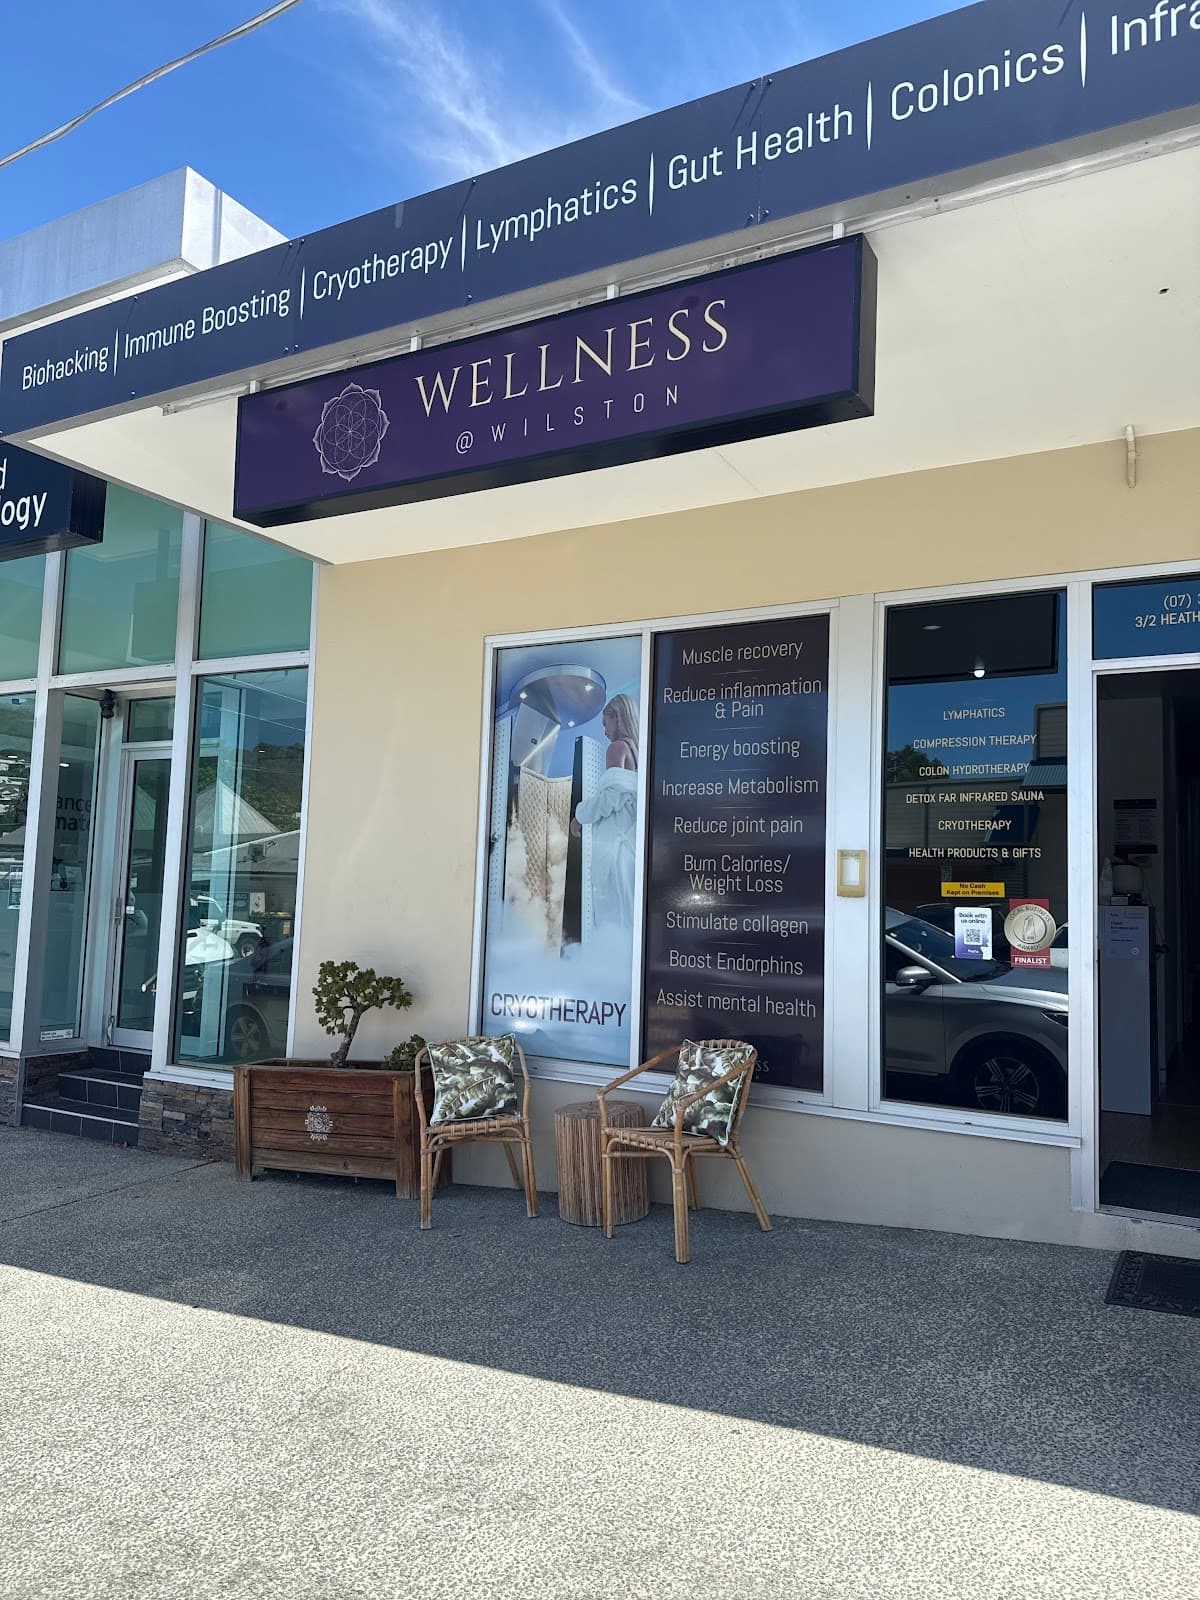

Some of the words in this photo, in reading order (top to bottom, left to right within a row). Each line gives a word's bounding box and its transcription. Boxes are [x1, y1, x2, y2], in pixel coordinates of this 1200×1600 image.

[22, 345, 109, 391] Biohacking
[123, 322, 195, 358] Immune
[201, 287, 291, 336] Boosting
[312, 234, 454, 301] Cryotherapy
[476, 178, 638, 254] Lymphatics
[667, 147, 723, 190] Gut
[735, 104, 853, 170] Health
[890, 43, 1065, 121] Colonics
[414, 298, 729, 418] WELLNESS
[456, 430, 474, 455] @
[491, 385, 680, 442] WILSTON
[1163, 593, 1192, 610] (07)
[1135, 614, 1157, 628] 3/2
[1161, 610, 1200, 625] HEATH
[682, 646, 733, 666] Muscle
[737, 641, 803, 660] recovery
[662, 686, 715, 704] Reduce
[720, 678, 822, 700] inflammation
[715, 703, 727, 720] &
[731, 701, 764, 718] Pain
[943, 707, 1005, 721] LYMPHATICS
[680, 742, 730, 761] Energy
[733, 737, 800, 759] boosting
[913, 737, 986, 749] COMPRESSION
[989, 734, 1037, 746] THERAPY
[919, 765, 950, 777] COLON
[952, 763, 1030, 775] HYDROTHERAPY
[662, 779, 723, 796] Increase
[728, 776, 819, 795] Metabolism
[906, 793, 936, 805] DETOX
[938, 793, 957, 804] FAR
[959, 791, 1009, 803] INFRARED
[1011, 790, 1045, 802] SAUNA
[673, 816, 727, 834] Reduce
[731, 816, 766, 836] joint
[771, 815, 803, 837] pain
[938, 819, 1012, 832] CRYOTHERAPY
[909, 847, 945, 859] HEALTH
[947, 846, 999, 859] PRODUCTS
[1001, 847, 1009, 858] &
[1013, 847, 1041, 859] GIFTS
[683, 855, 717, 873] Burn
[721, 854, 791, 873] Calories/
[690, 875, 741, 895] Weight
[746, 875, 784, 893] Loss
[666, 911, 738, 931] Stimulate
[742, 915, 809, 937] collagen
[669, 950, 713, 970] Boost
[717, 953, 804, 976] Endorphins
[1014, 957, 1047, 965] FINALIST
[491, 992, 627, 1027] CRYOTHERAPY
[656, 989, 703, 1009] Assist
[707, 995, 761, 1013] mental
[765, 995, 817, 1019] health
